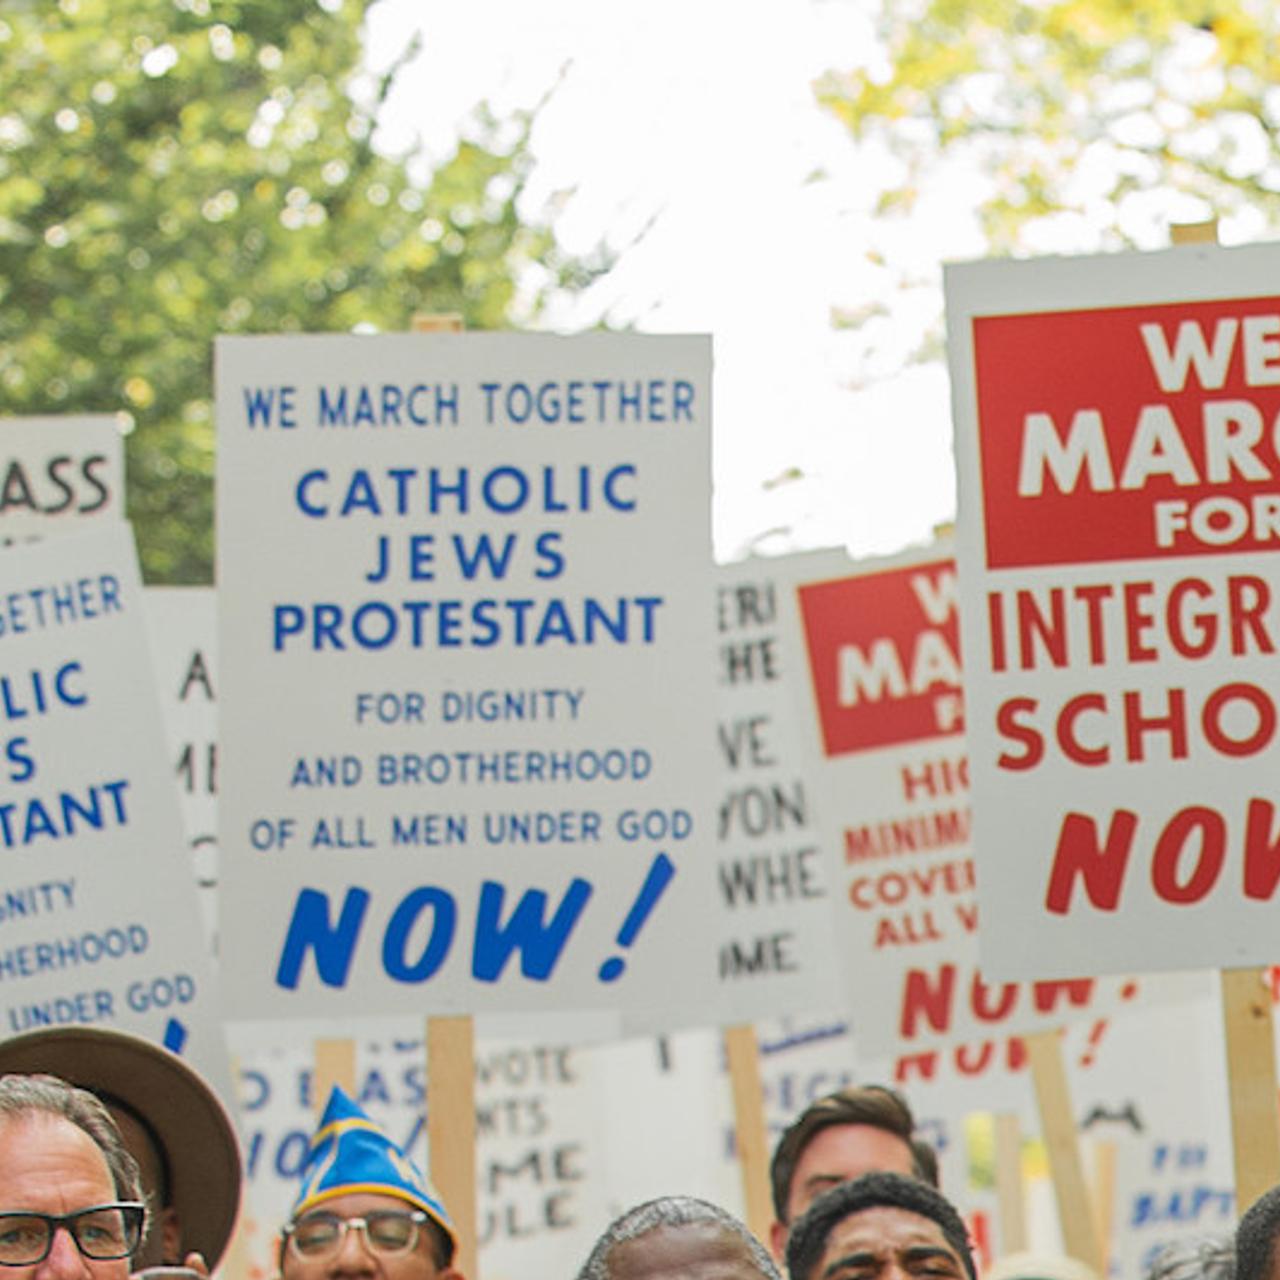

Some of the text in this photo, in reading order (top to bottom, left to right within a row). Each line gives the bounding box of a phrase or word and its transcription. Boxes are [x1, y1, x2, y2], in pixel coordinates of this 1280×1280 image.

[243, 380, 696, 430] WE MARCH TOGETHER
[295, 464, 637, 518] CATHOLIC
[365, 533, 566, 582] JEWS
[0, 574, 122, 637] ETHER
[273, 597, 663, 651] PROTESTANT
[836, 629, 964, 708] MA
[356, 689, 585, 724] FOR DIGNITY
[290, 750, 653, 788] AND BROTHERHOOD
[250, 809, 693, 851] OF ALL MEN UNDER GOD
[848, 859, 977, 910] COVE
[275, 852, 676, 990] NOW!
[874, 913, 943, 950] ALL
[9, 973, 196, 1033] UNDER GOD
